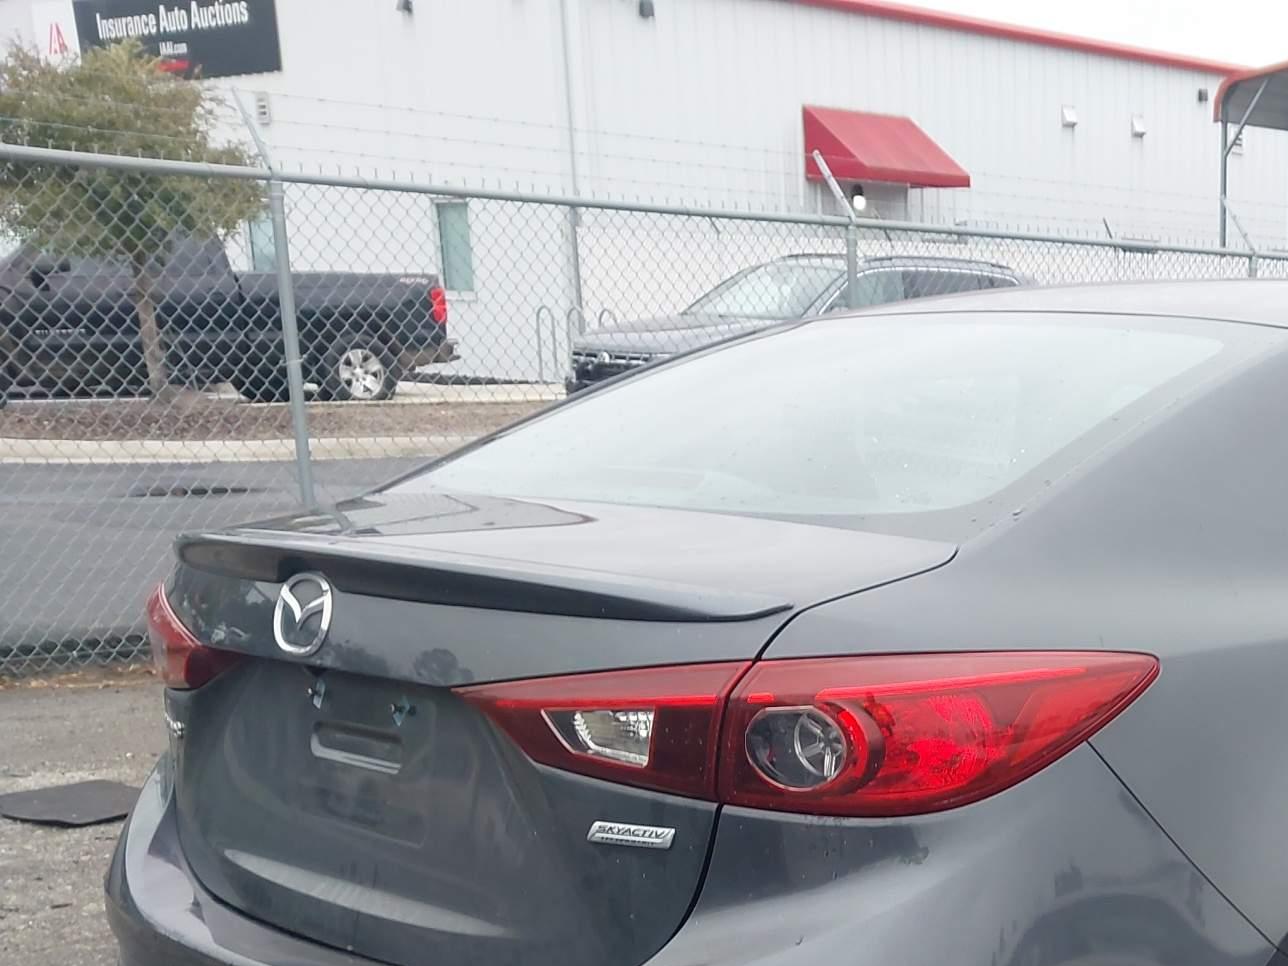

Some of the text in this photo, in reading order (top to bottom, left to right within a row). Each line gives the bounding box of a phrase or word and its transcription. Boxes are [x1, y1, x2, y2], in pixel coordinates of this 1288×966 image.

[96, 0, 249, 40] Insurance Auto Auctions
[597, 824, 671, 840] SKYACTIV
